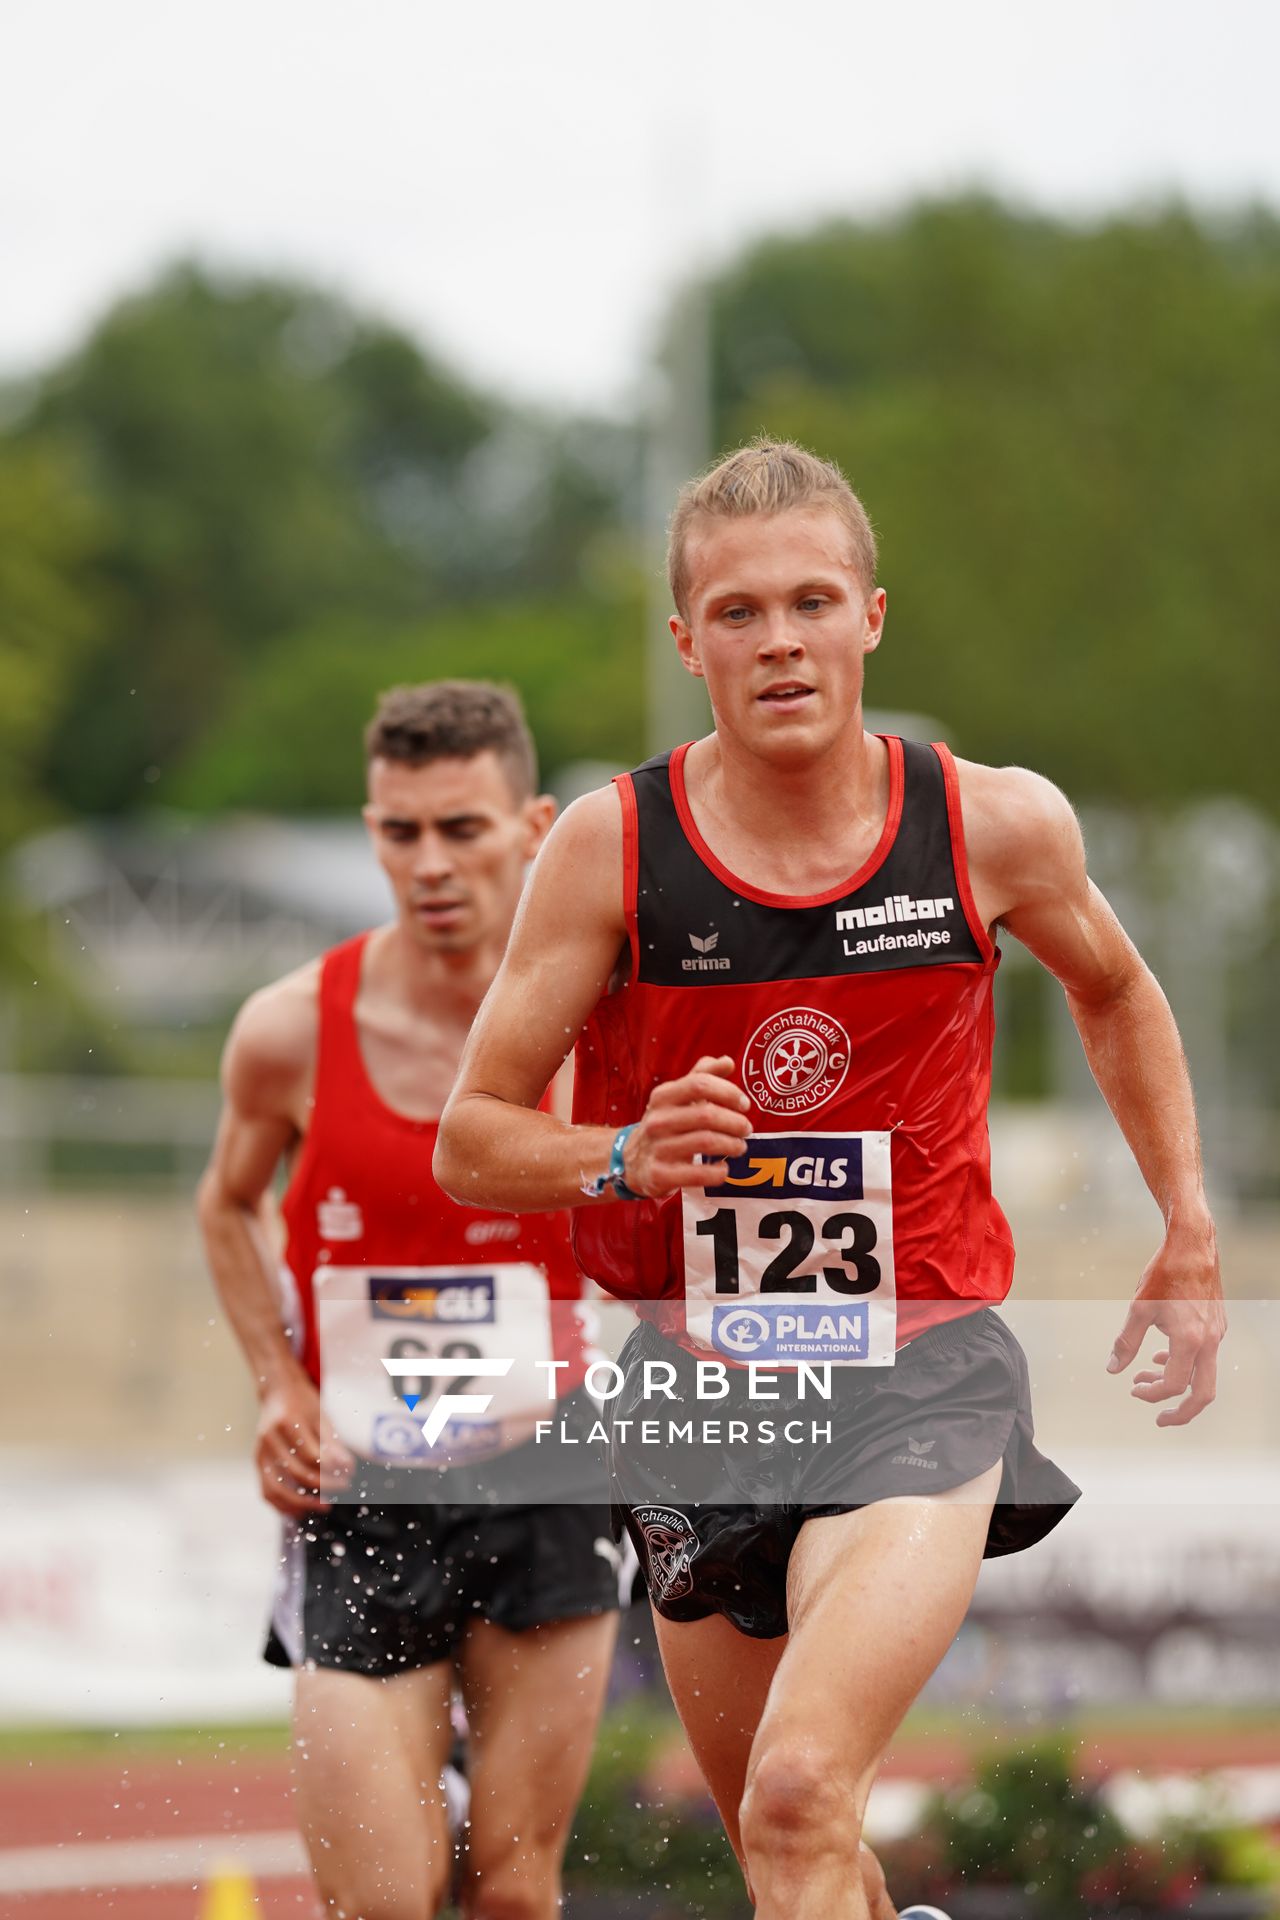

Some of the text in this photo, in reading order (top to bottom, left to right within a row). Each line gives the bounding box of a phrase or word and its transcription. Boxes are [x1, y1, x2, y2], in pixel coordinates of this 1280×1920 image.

[836, 895, 954, 931] molitor
[843, 929, 951, 956] Laufanalyse
[681, 956, 731, 970] erima
[755, 1014, 841, 1049] Leichtathletik
[752, 1075, 835, 1110] OSNABRÜCK
[788, 1156, 848, 1188] GLS
[696, 1208, 882, 1295] 123
[776, 1315, 862, 1340] PLAN
[776, 1344, 862, 1353] INTERNATIONAL
[890, 1455, 939, 1470] erima
